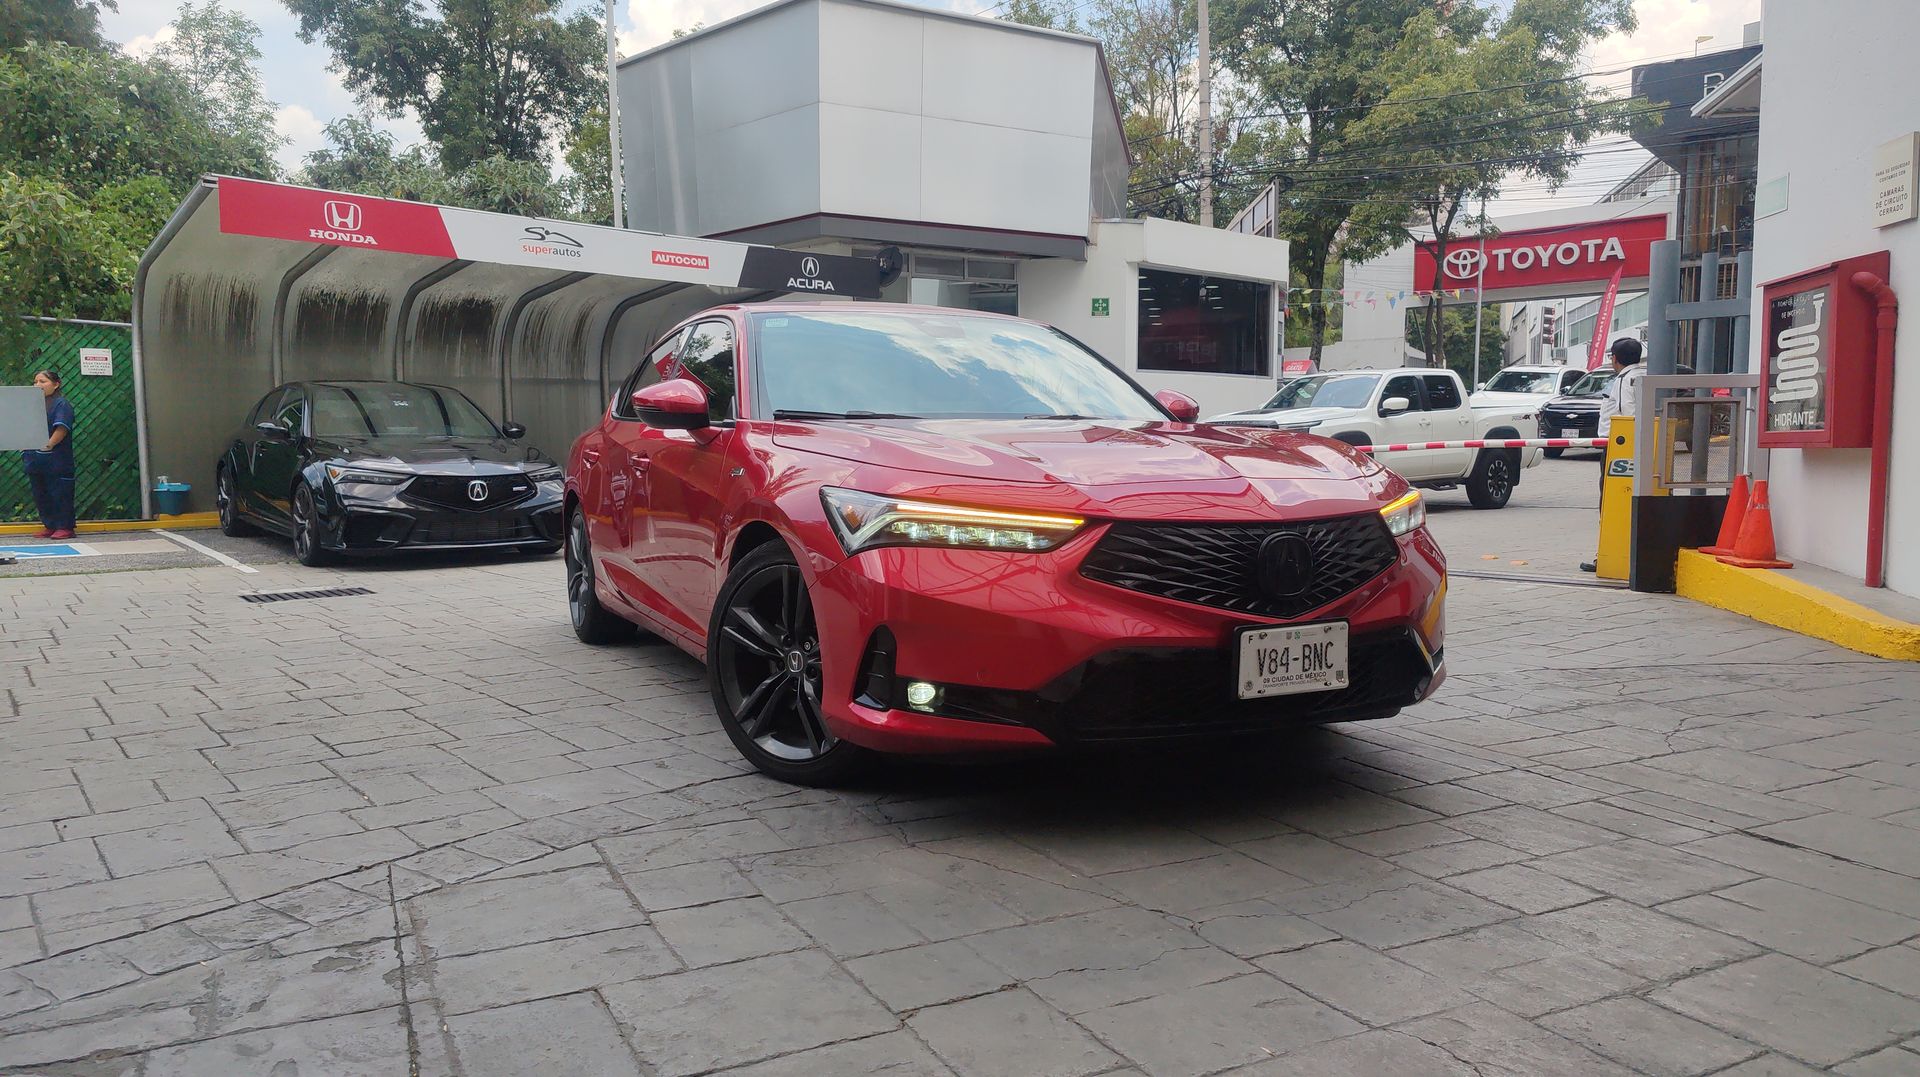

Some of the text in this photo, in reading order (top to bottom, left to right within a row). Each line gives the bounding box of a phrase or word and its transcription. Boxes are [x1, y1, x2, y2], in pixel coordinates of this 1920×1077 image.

[1879, 184, 1905, 199] CAMARAS
[1875, 192, 1909, 209] DE CIRCUITO
[1878, 203, 1904, 217] CERRADO
[309, 229, 378, 245] HONDA
[522, 243, 582, 258] superautos
[1491, 236, 1626, 272] TOYOTA
[654, 252, 707, 267] AUTOCOM
[786, 277, 835, 291] ACURA
[1774, 410, 1815, 427] HIDRANTE
[1612, 459, 1634, 474] S
[1257, 641, 1334, 677] V84-BNC
[1271, 674, 1294, 683] CIUDAD
[1295, 673, 1304, 681] DE
[1304, 671, 1327, 680] MÉXICO
